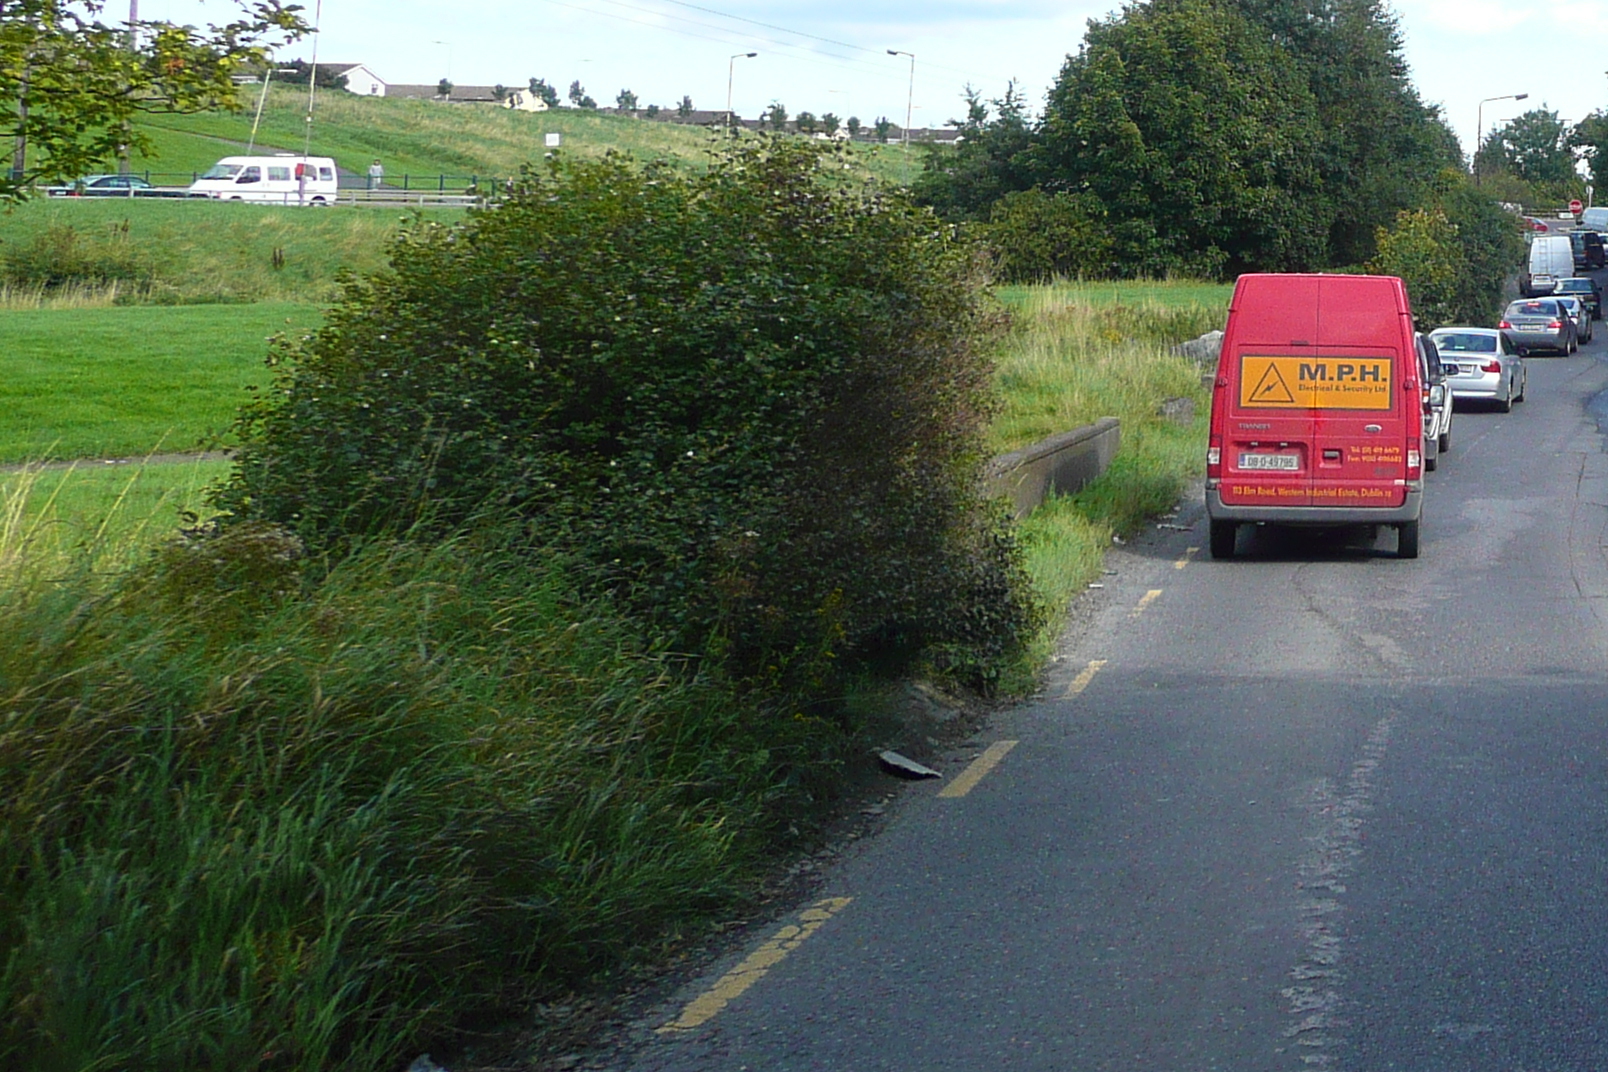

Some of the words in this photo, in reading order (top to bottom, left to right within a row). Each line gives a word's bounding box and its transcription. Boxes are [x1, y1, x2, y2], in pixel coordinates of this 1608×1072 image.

[1299, 363, 1388, 382] M.P.H.
[1299, 383, 1334, 392] Electrical
[1343, 385, 1373, 395] Security
[1278, 487, 1304, 497] Western
[1306, 487, 1337, 497] Industrial
[1361, 488, 1383, 497] Dublin
